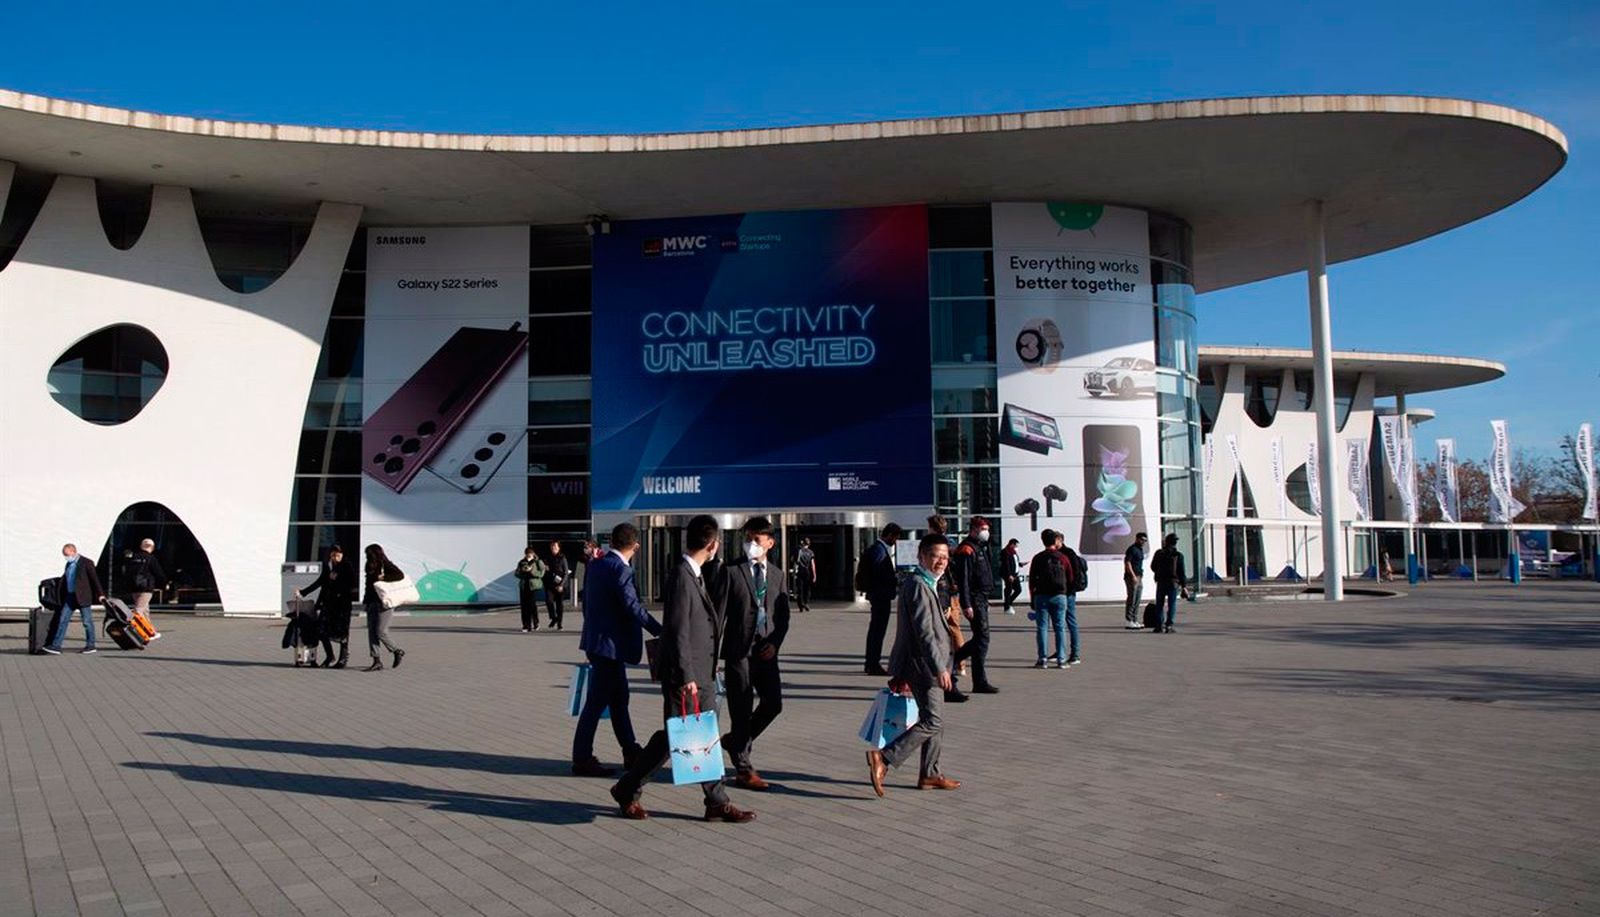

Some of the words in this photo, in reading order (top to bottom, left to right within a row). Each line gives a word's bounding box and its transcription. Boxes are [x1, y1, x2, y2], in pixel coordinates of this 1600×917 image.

[376, 235, 427, 245] SAMSUNG
[663, 236, 707, 250] MWC
[1010, 256, 1096, 274] Everything
[1100, 260, 1140, 274] works
[397, 279, 439, 291] Galaxy
[441, 279, 461, 289] S22
[463, 278, 499, 289] Series
[1015, 276, 1067, 290] better
[1071, 277, 1136, 294] together
[641, 304, 876, 338] CONNECTIVITY
[643, 337, 876, 373] UNLEASHED
[551, 481, 583, 495] Will
[642, 476, 701, 494] WELCOME
